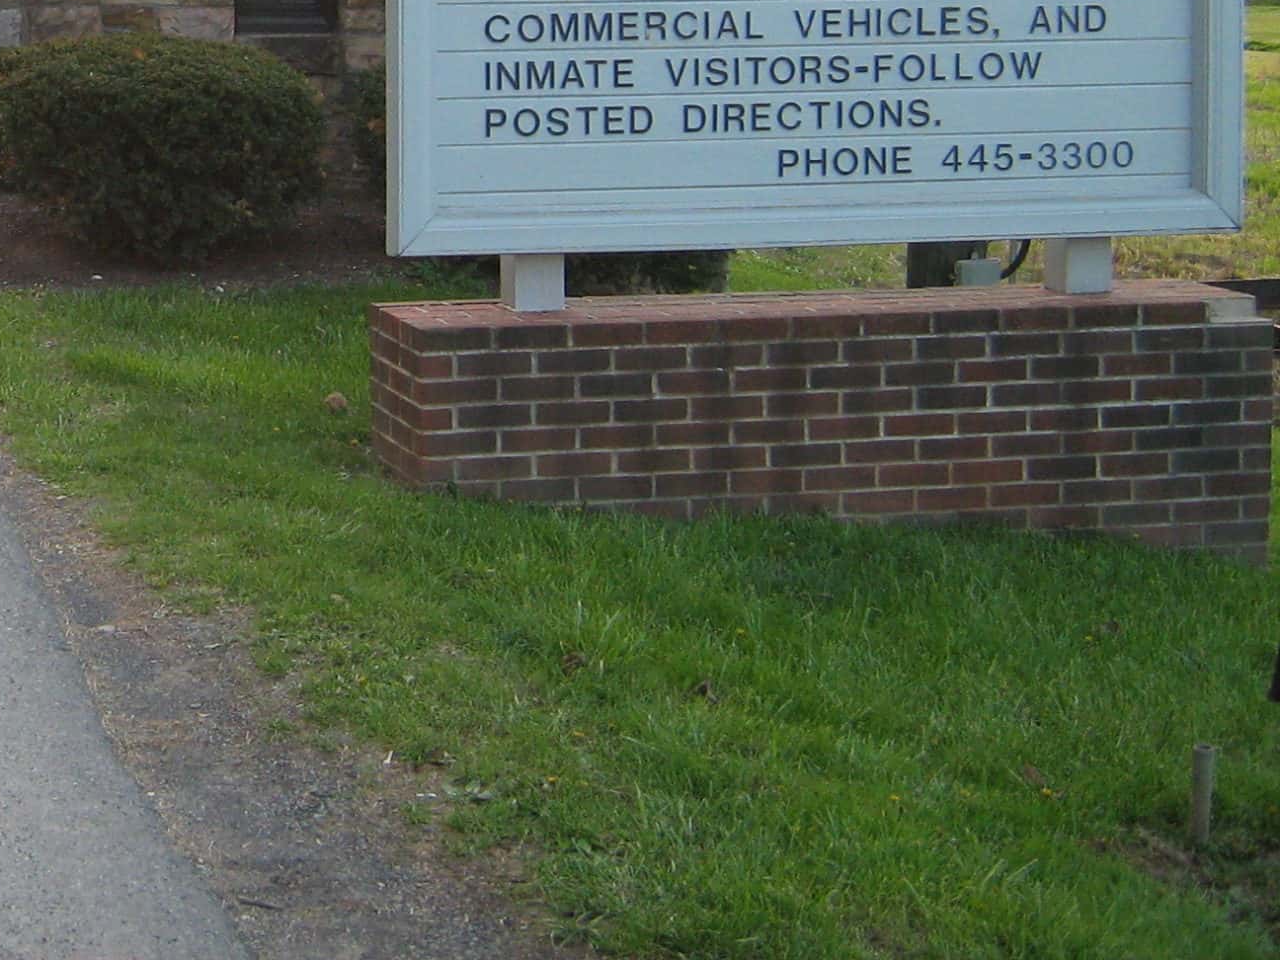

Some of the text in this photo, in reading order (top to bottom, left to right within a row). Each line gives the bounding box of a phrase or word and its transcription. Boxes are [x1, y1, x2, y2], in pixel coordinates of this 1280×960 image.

[483, 4, 1107, 44] COMMERCIAL VEHICLES, AND
[484, 51, 1043, 92] INMATE VISITORS-FOLLOW
[484, 98, 942, 139] POSTED DIRECTIONS.
[776, 140, 1134, 179] PHONE 445-3300
